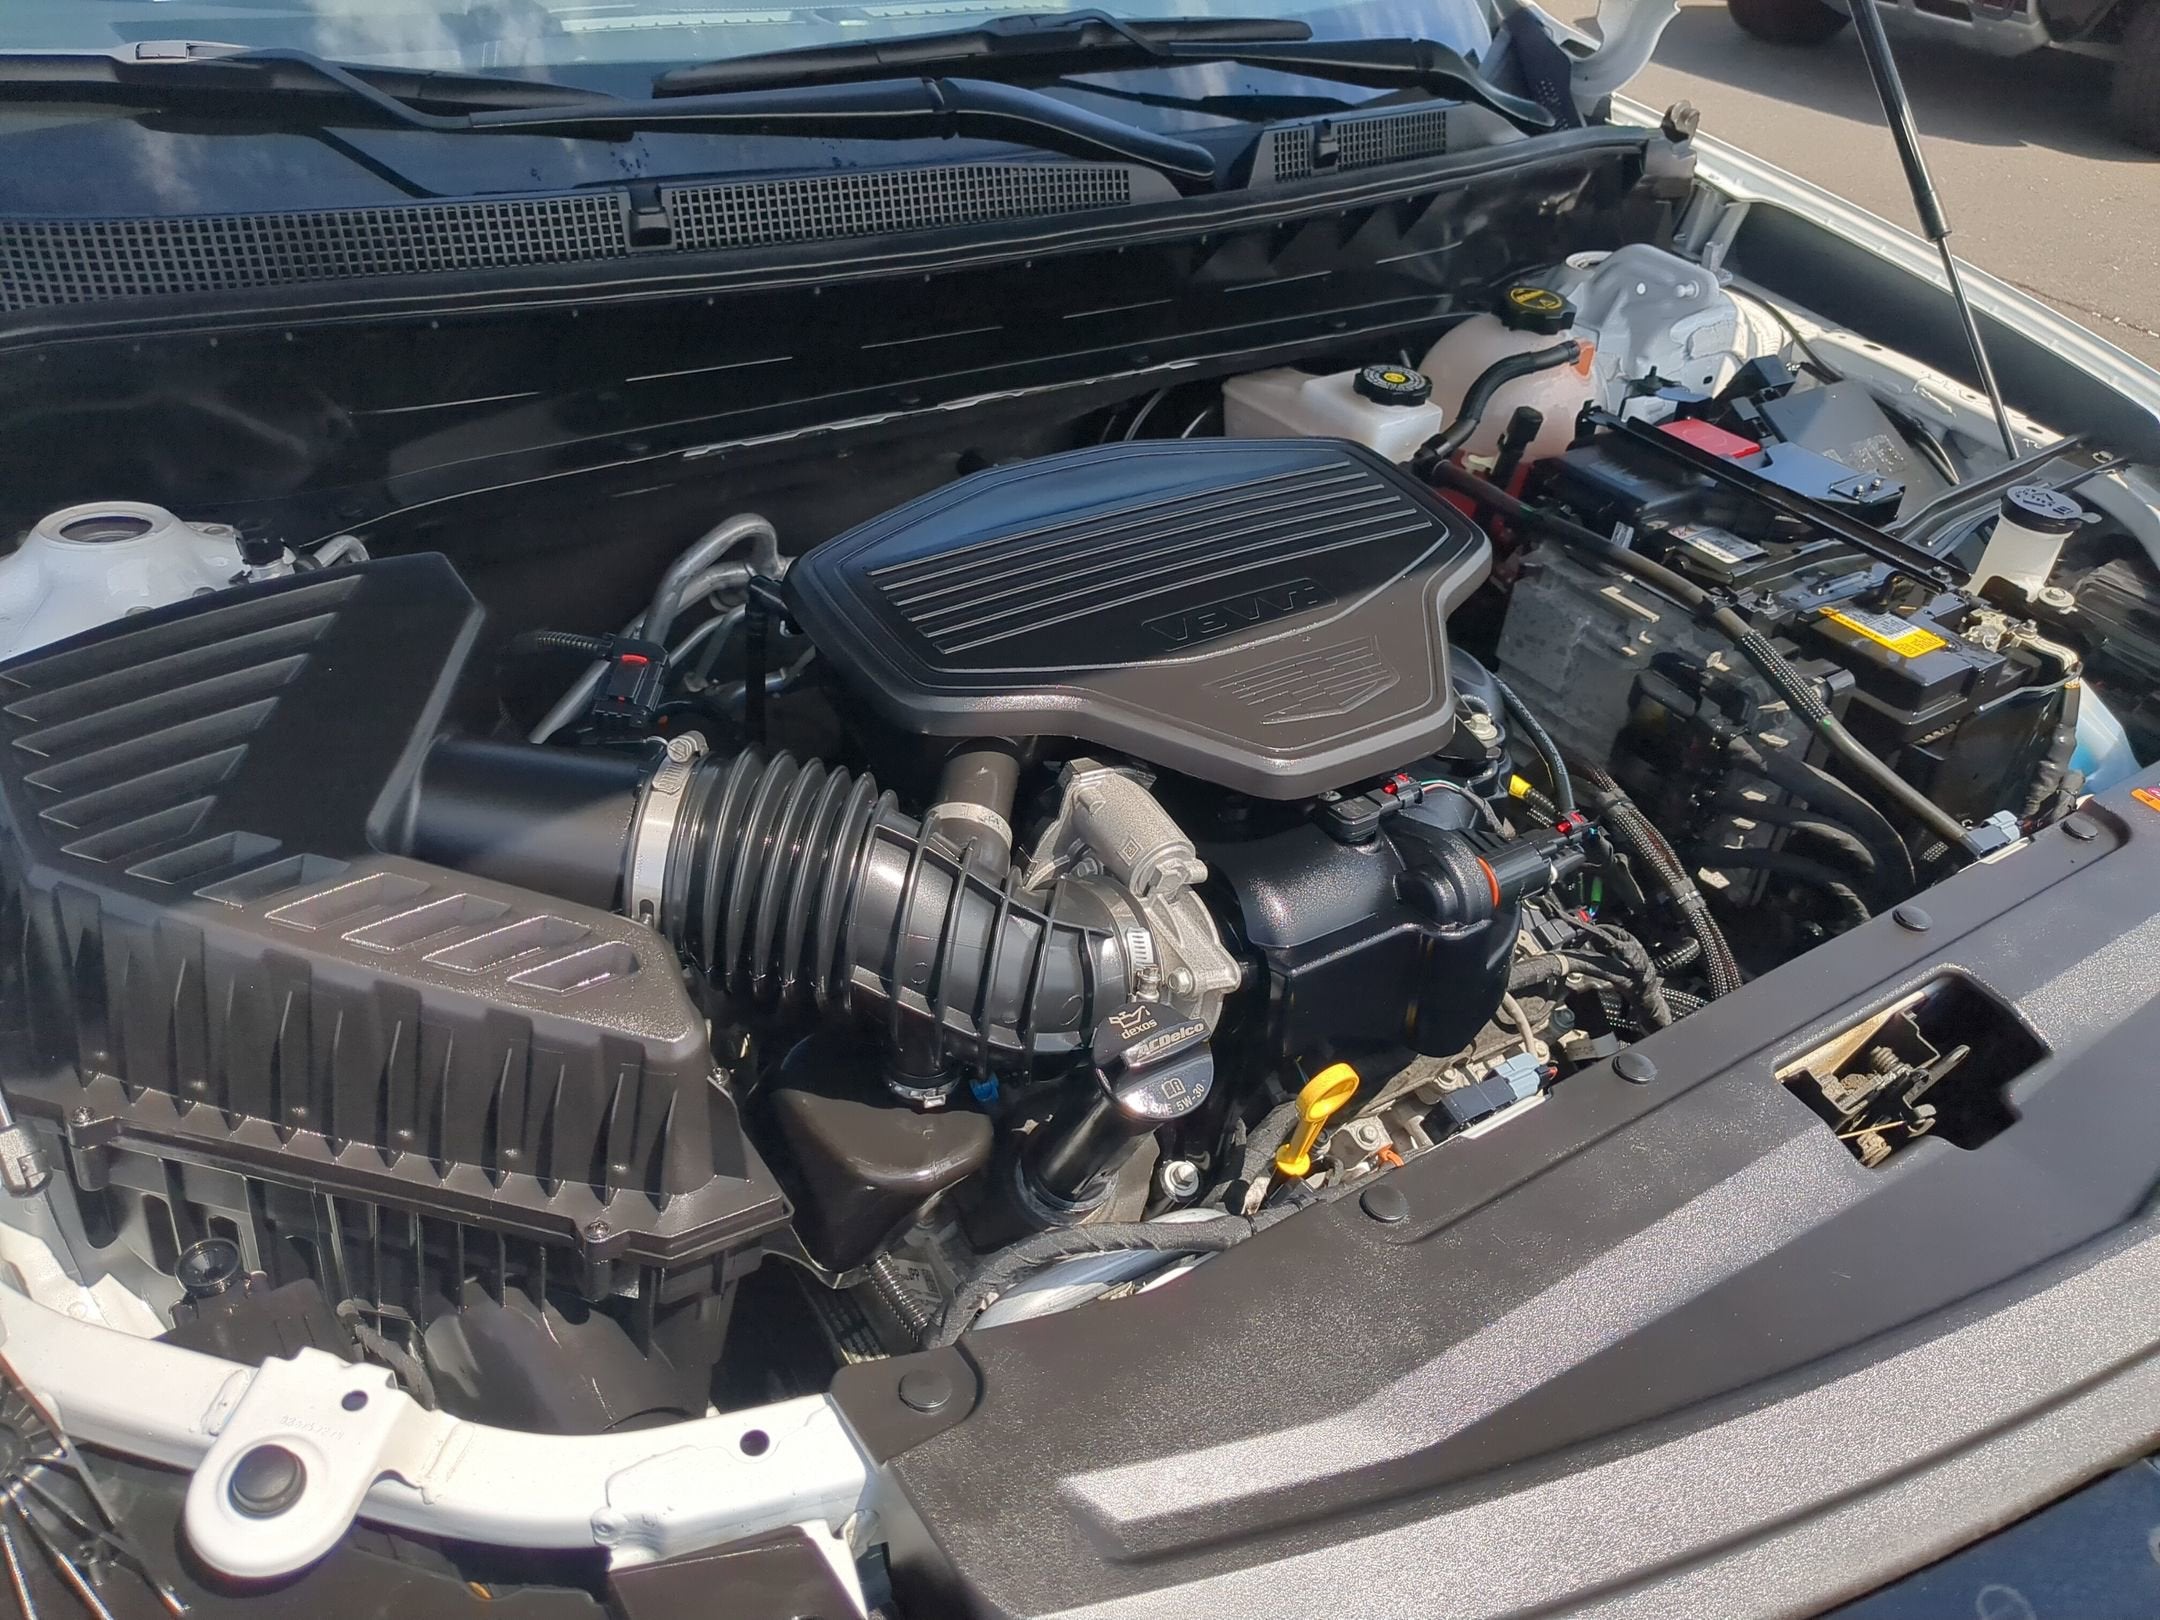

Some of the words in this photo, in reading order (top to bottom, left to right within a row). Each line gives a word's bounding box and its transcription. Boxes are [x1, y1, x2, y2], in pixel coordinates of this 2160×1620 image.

[1121, 1018, 1158, 1040] dexos
[1136, 1022, 1205, 1058] ACDelco
[1176, 1083, 1205, 1112] 5W-30
